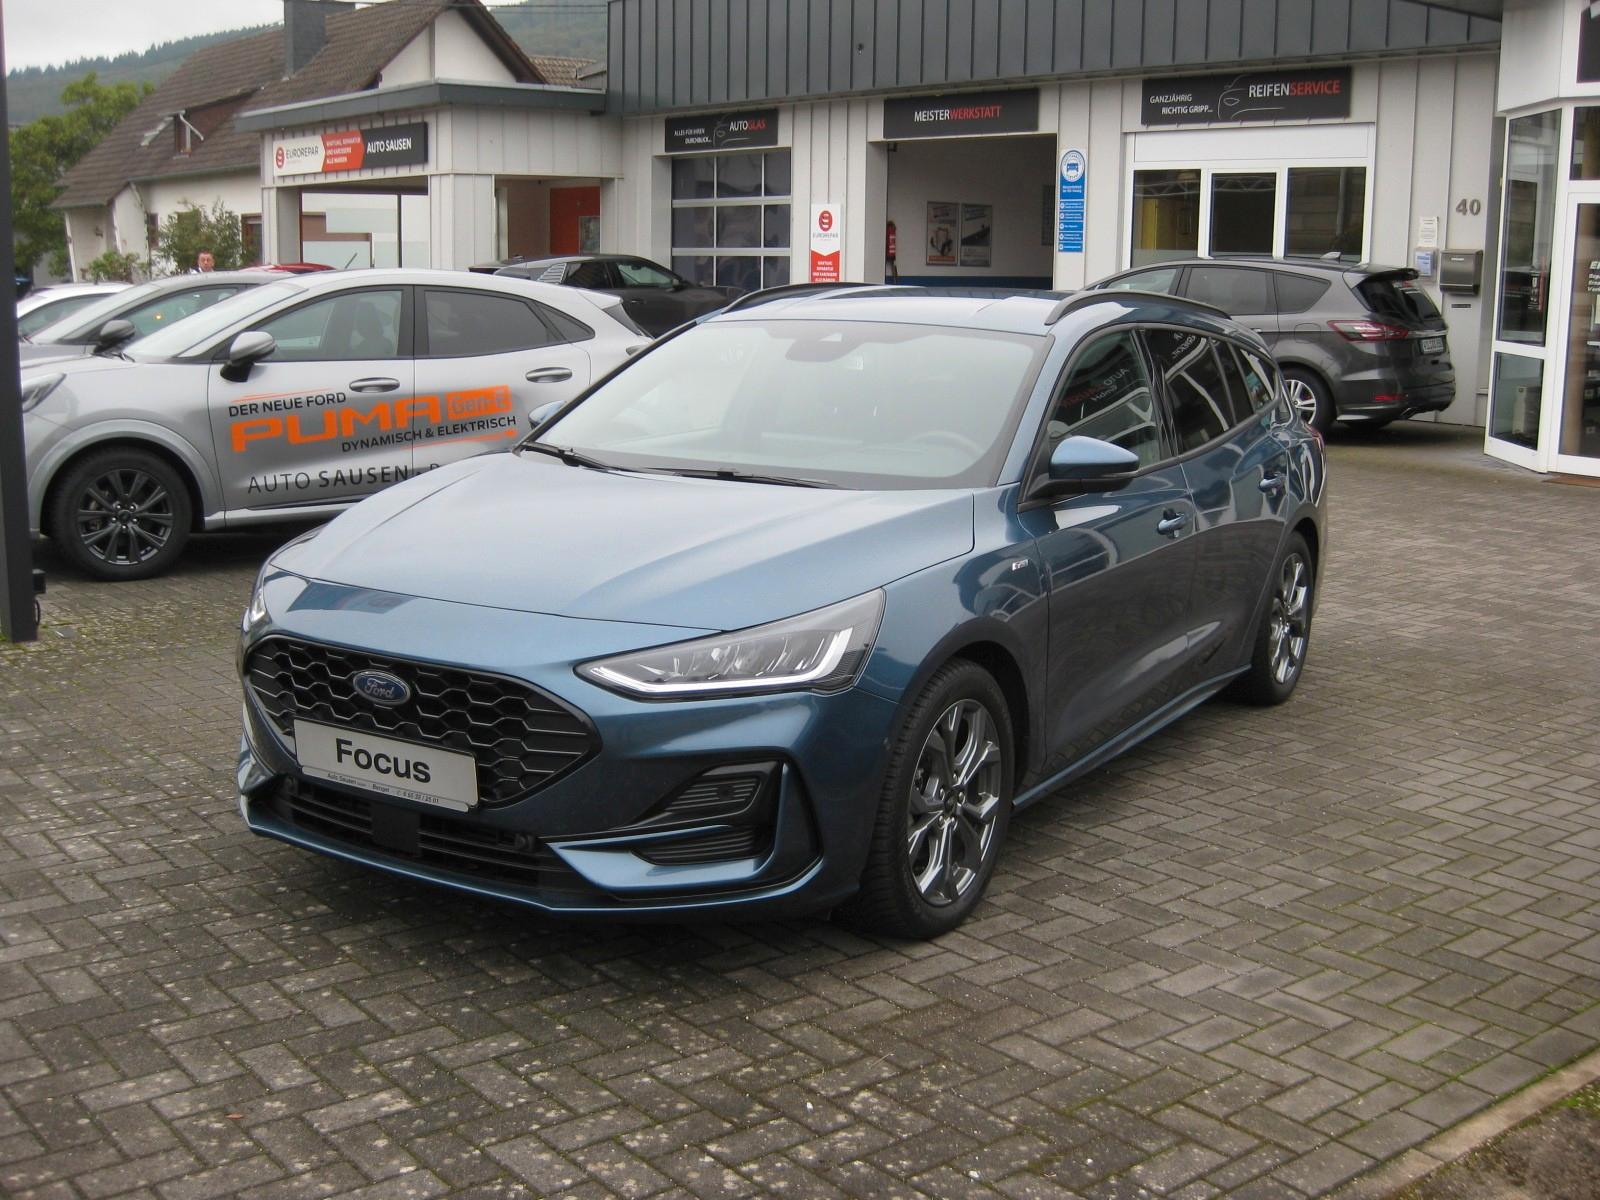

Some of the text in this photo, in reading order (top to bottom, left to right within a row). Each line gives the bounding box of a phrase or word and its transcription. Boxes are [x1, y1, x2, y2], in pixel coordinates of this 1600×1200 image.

[1248, 80, 1341, 98] REIFENSERVICE
[1149, 94, 1193, 104] GANZJÄHRIG
[914, 105, 1002, 122] MEISTERWERKSTATT
[1161, 105, 1188, 115] RICHTIG
[729, 119, 766, 132] AUTOGLAS
[286, 145, 319, 160] EUROREPAR
[366, 137, 412, 154] AUTO SAUSEN
[1455, 198, 1481, 216] 40
[228, 392, 347, 417] DER NEUE FORD
[230, 395, 442, 452] PUMA
[341, 415, 517, 453] DYNAMISCH & ELEKTRISCH
[247, 464, 409, 494] AUTO SAUSEN
[363, 677, 395, 698] Ford
[335, 737, 431, 784] Focus
